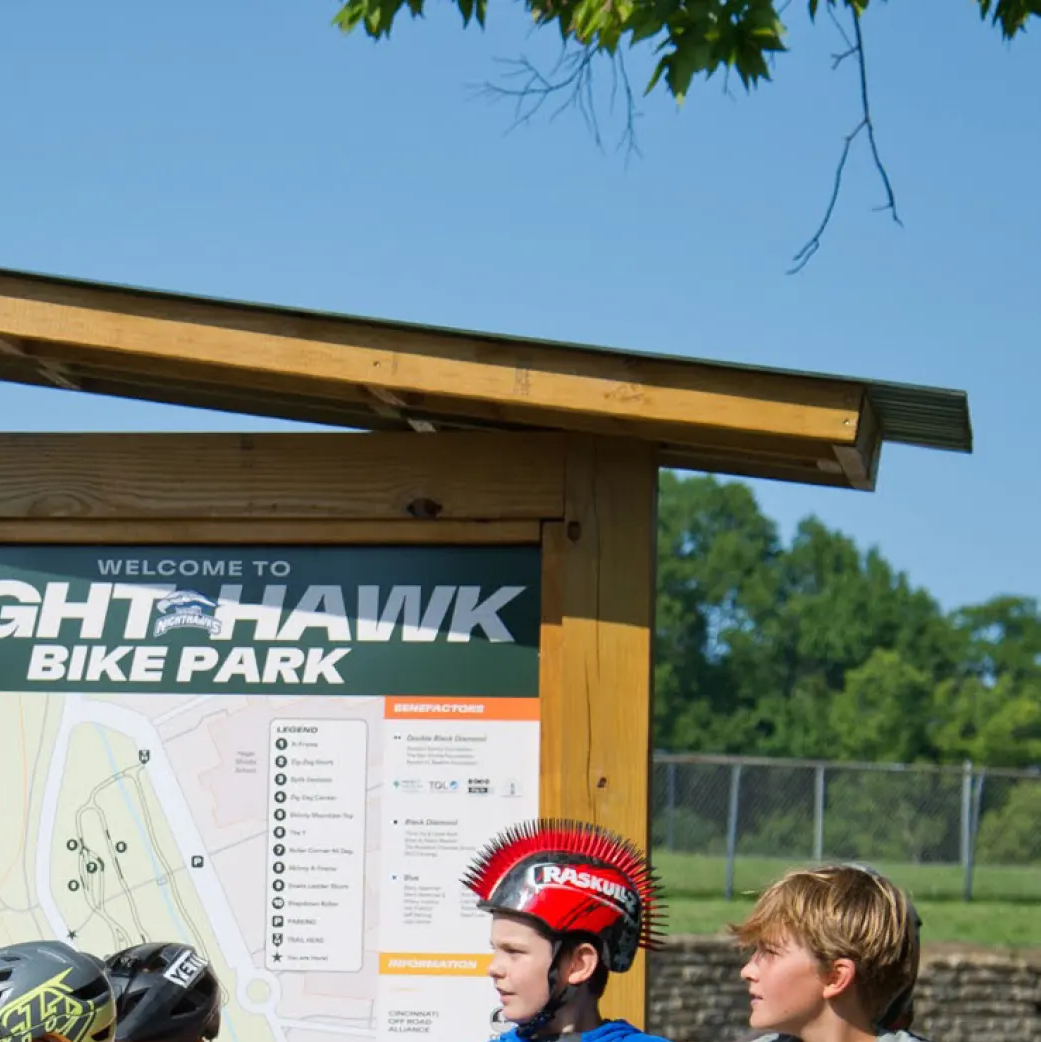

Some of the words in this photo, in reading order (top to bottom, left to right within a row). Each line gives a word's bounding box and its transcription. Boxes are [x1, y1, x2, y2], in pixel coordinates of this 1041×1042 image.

[98, 559, 242, 576] WELCOME
[252, 560, 291, 577] TO
[210, 584, 527, 642] HAWK
[27, 644, 168, 682] BIKE
[176, 646, 352, 684] PARK
[393, 703, 485, 713] BENEFACTORS
[276, 726, 318, 734] LEGEND
[388, 959, 477, 969] INFORMATION
